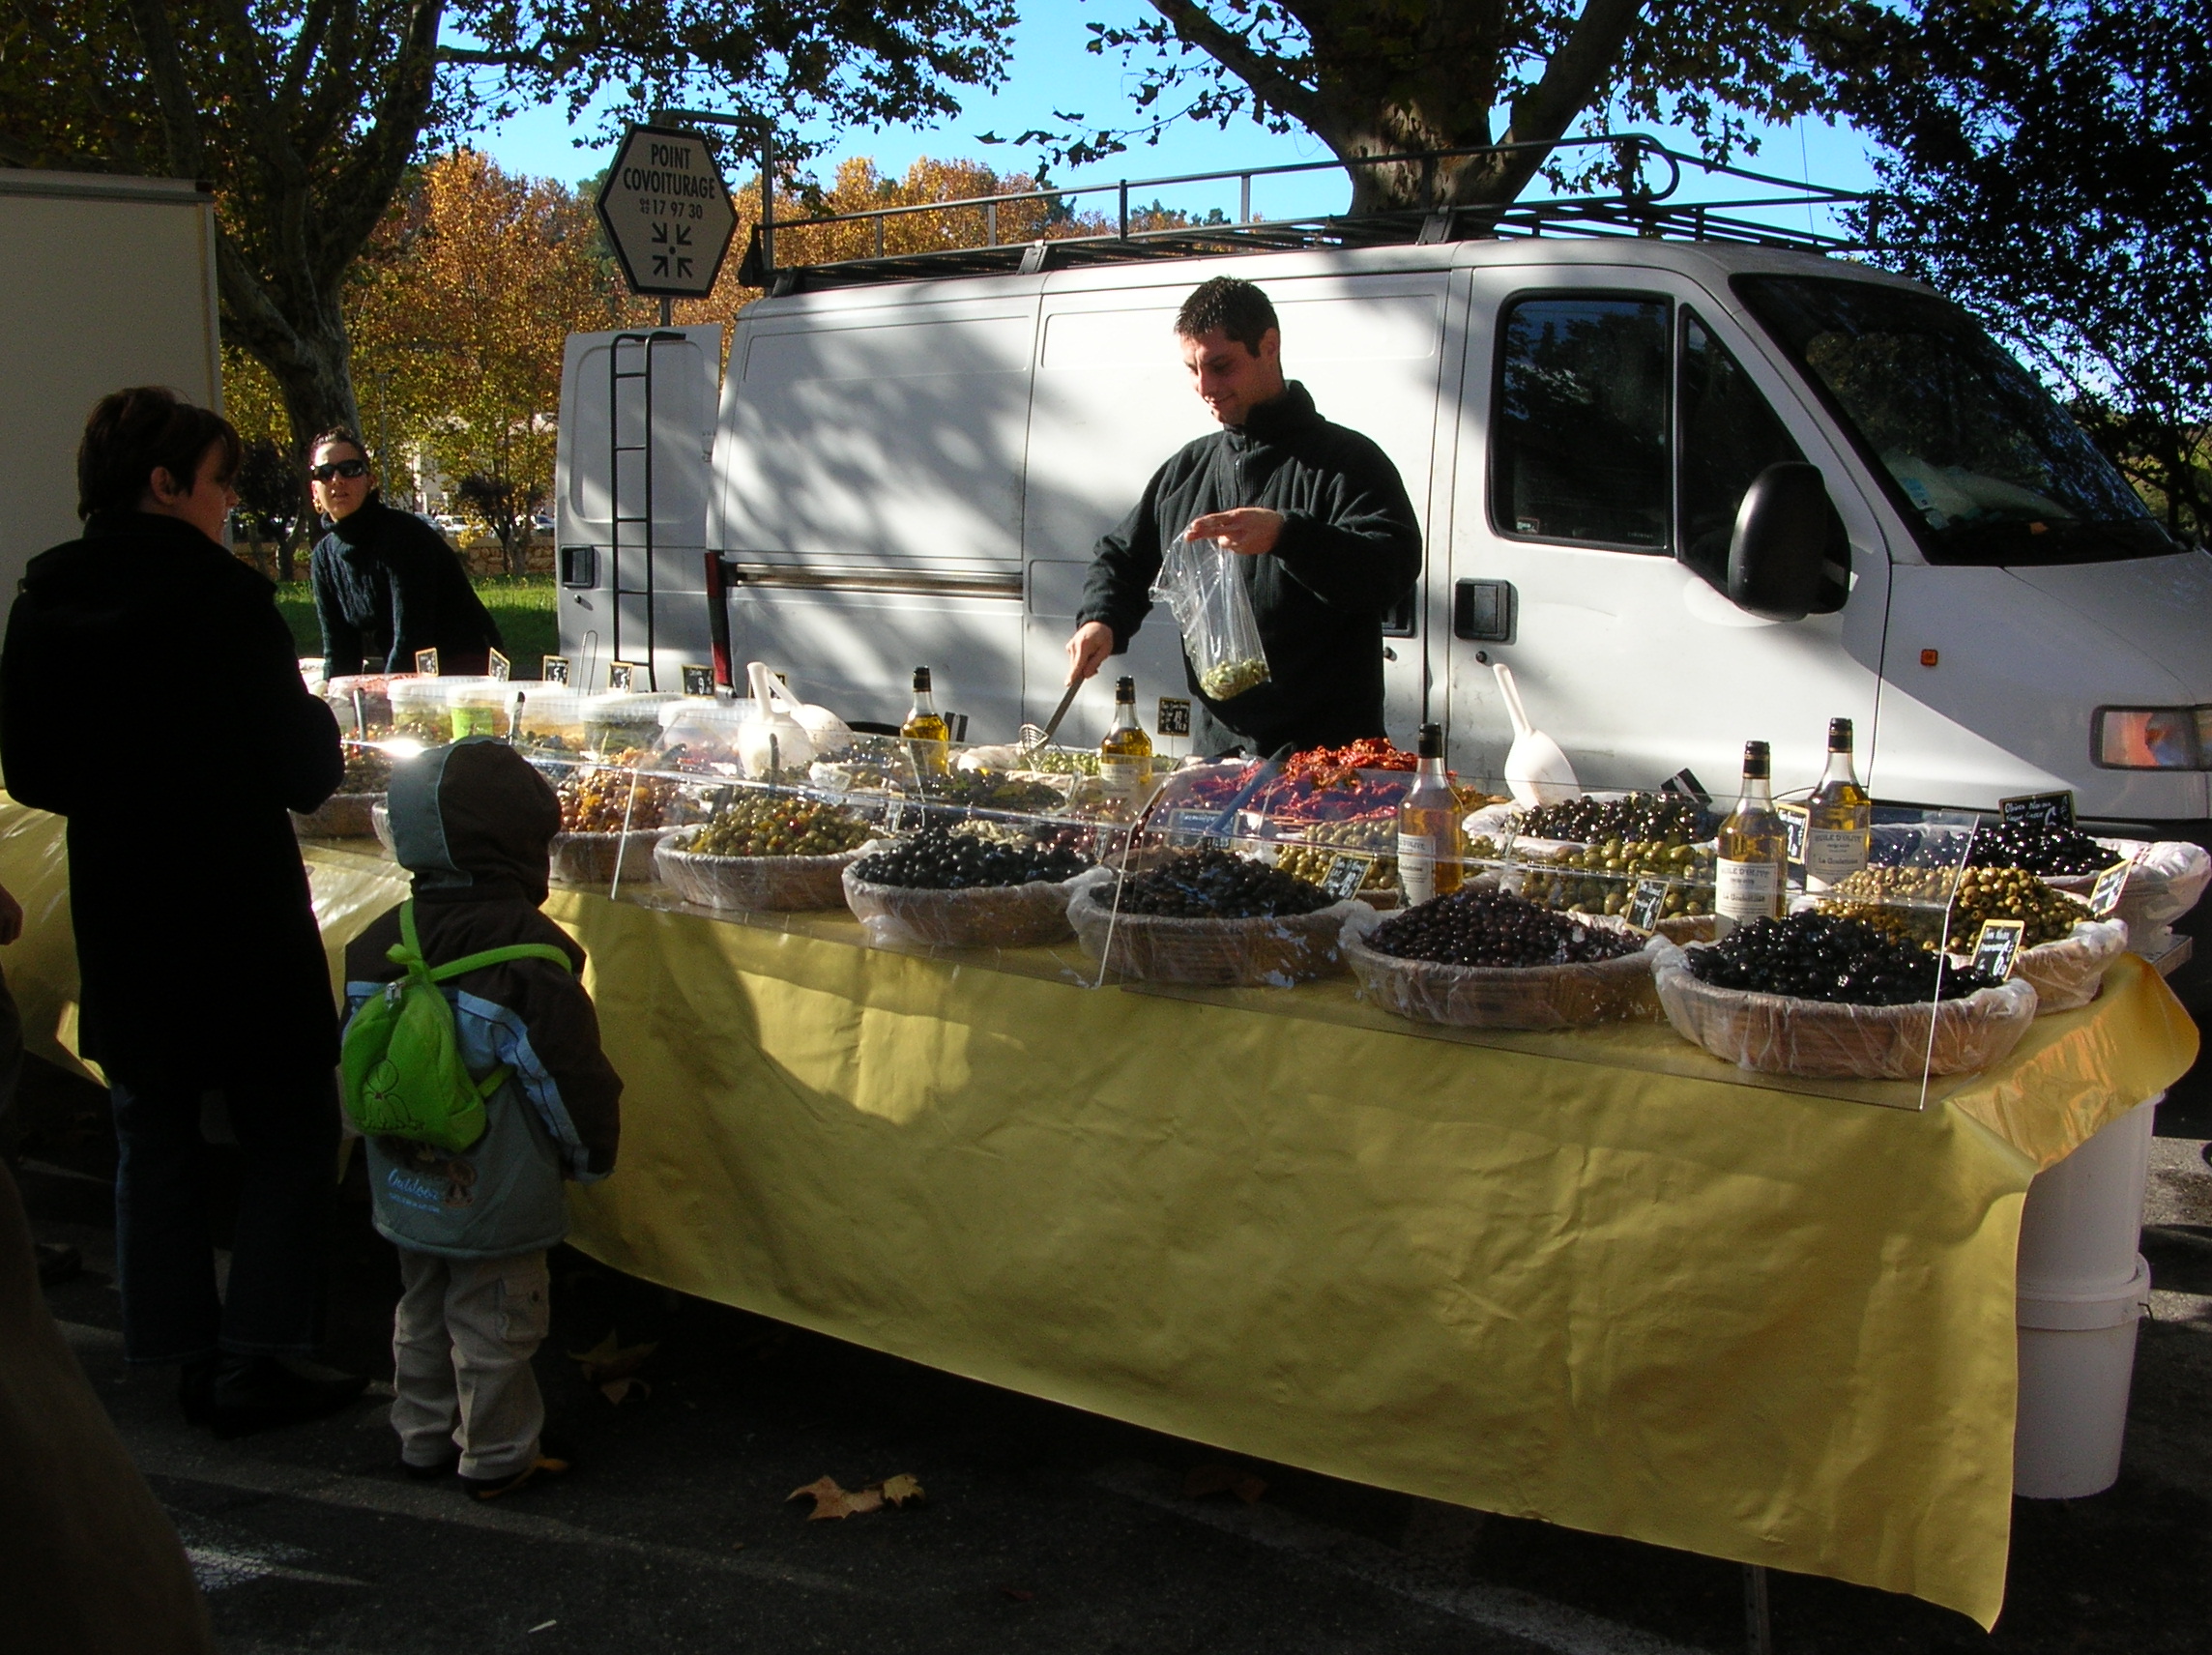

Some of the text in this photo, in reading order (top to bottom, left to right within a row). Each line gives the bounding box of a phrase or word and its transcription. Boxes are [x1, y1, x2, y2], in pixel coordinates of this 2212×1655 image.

[651, 144, 691, 169] POINT
[623, 167, 715, 199] COVOITURAGE
[653, 199, 666, 215] 17
[670, 201, 684, 218] 97
[688, 203, 704, 220] 30
